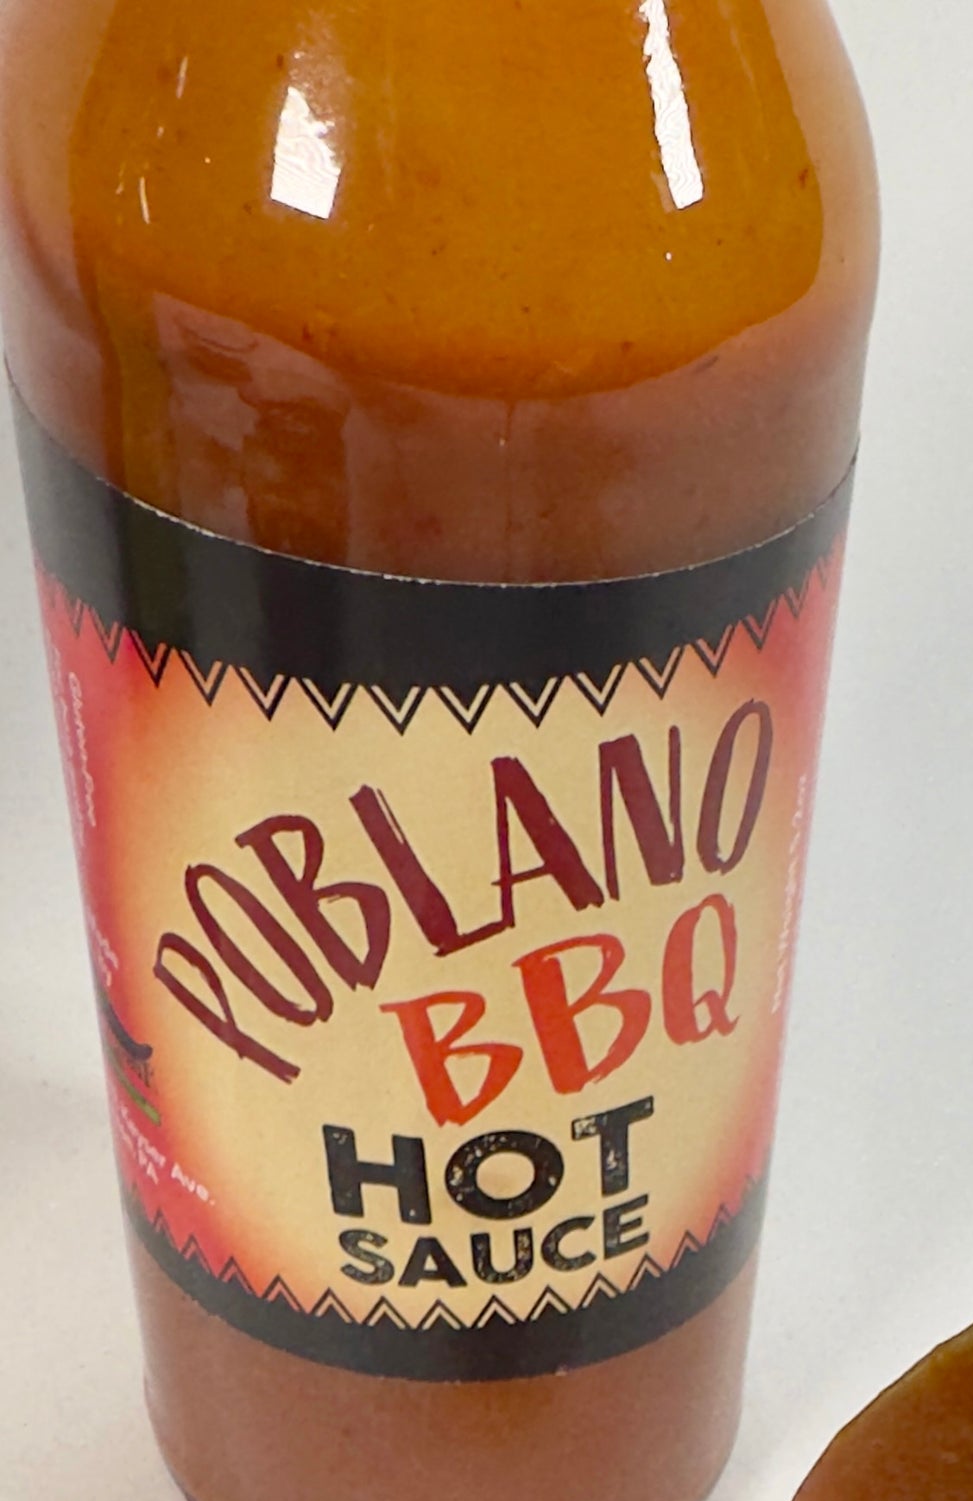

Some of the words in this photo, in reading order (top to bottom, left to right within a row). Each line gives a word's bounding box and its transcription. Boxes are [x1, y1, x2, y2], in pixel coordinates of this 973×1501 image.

[153, 698, 774, 1084] POBLANO
[379, 893, 741, 1127] BBQ
[322, 1095, 654, 1225] HOT
[339, 1194, 650, 1288] SAUCE
